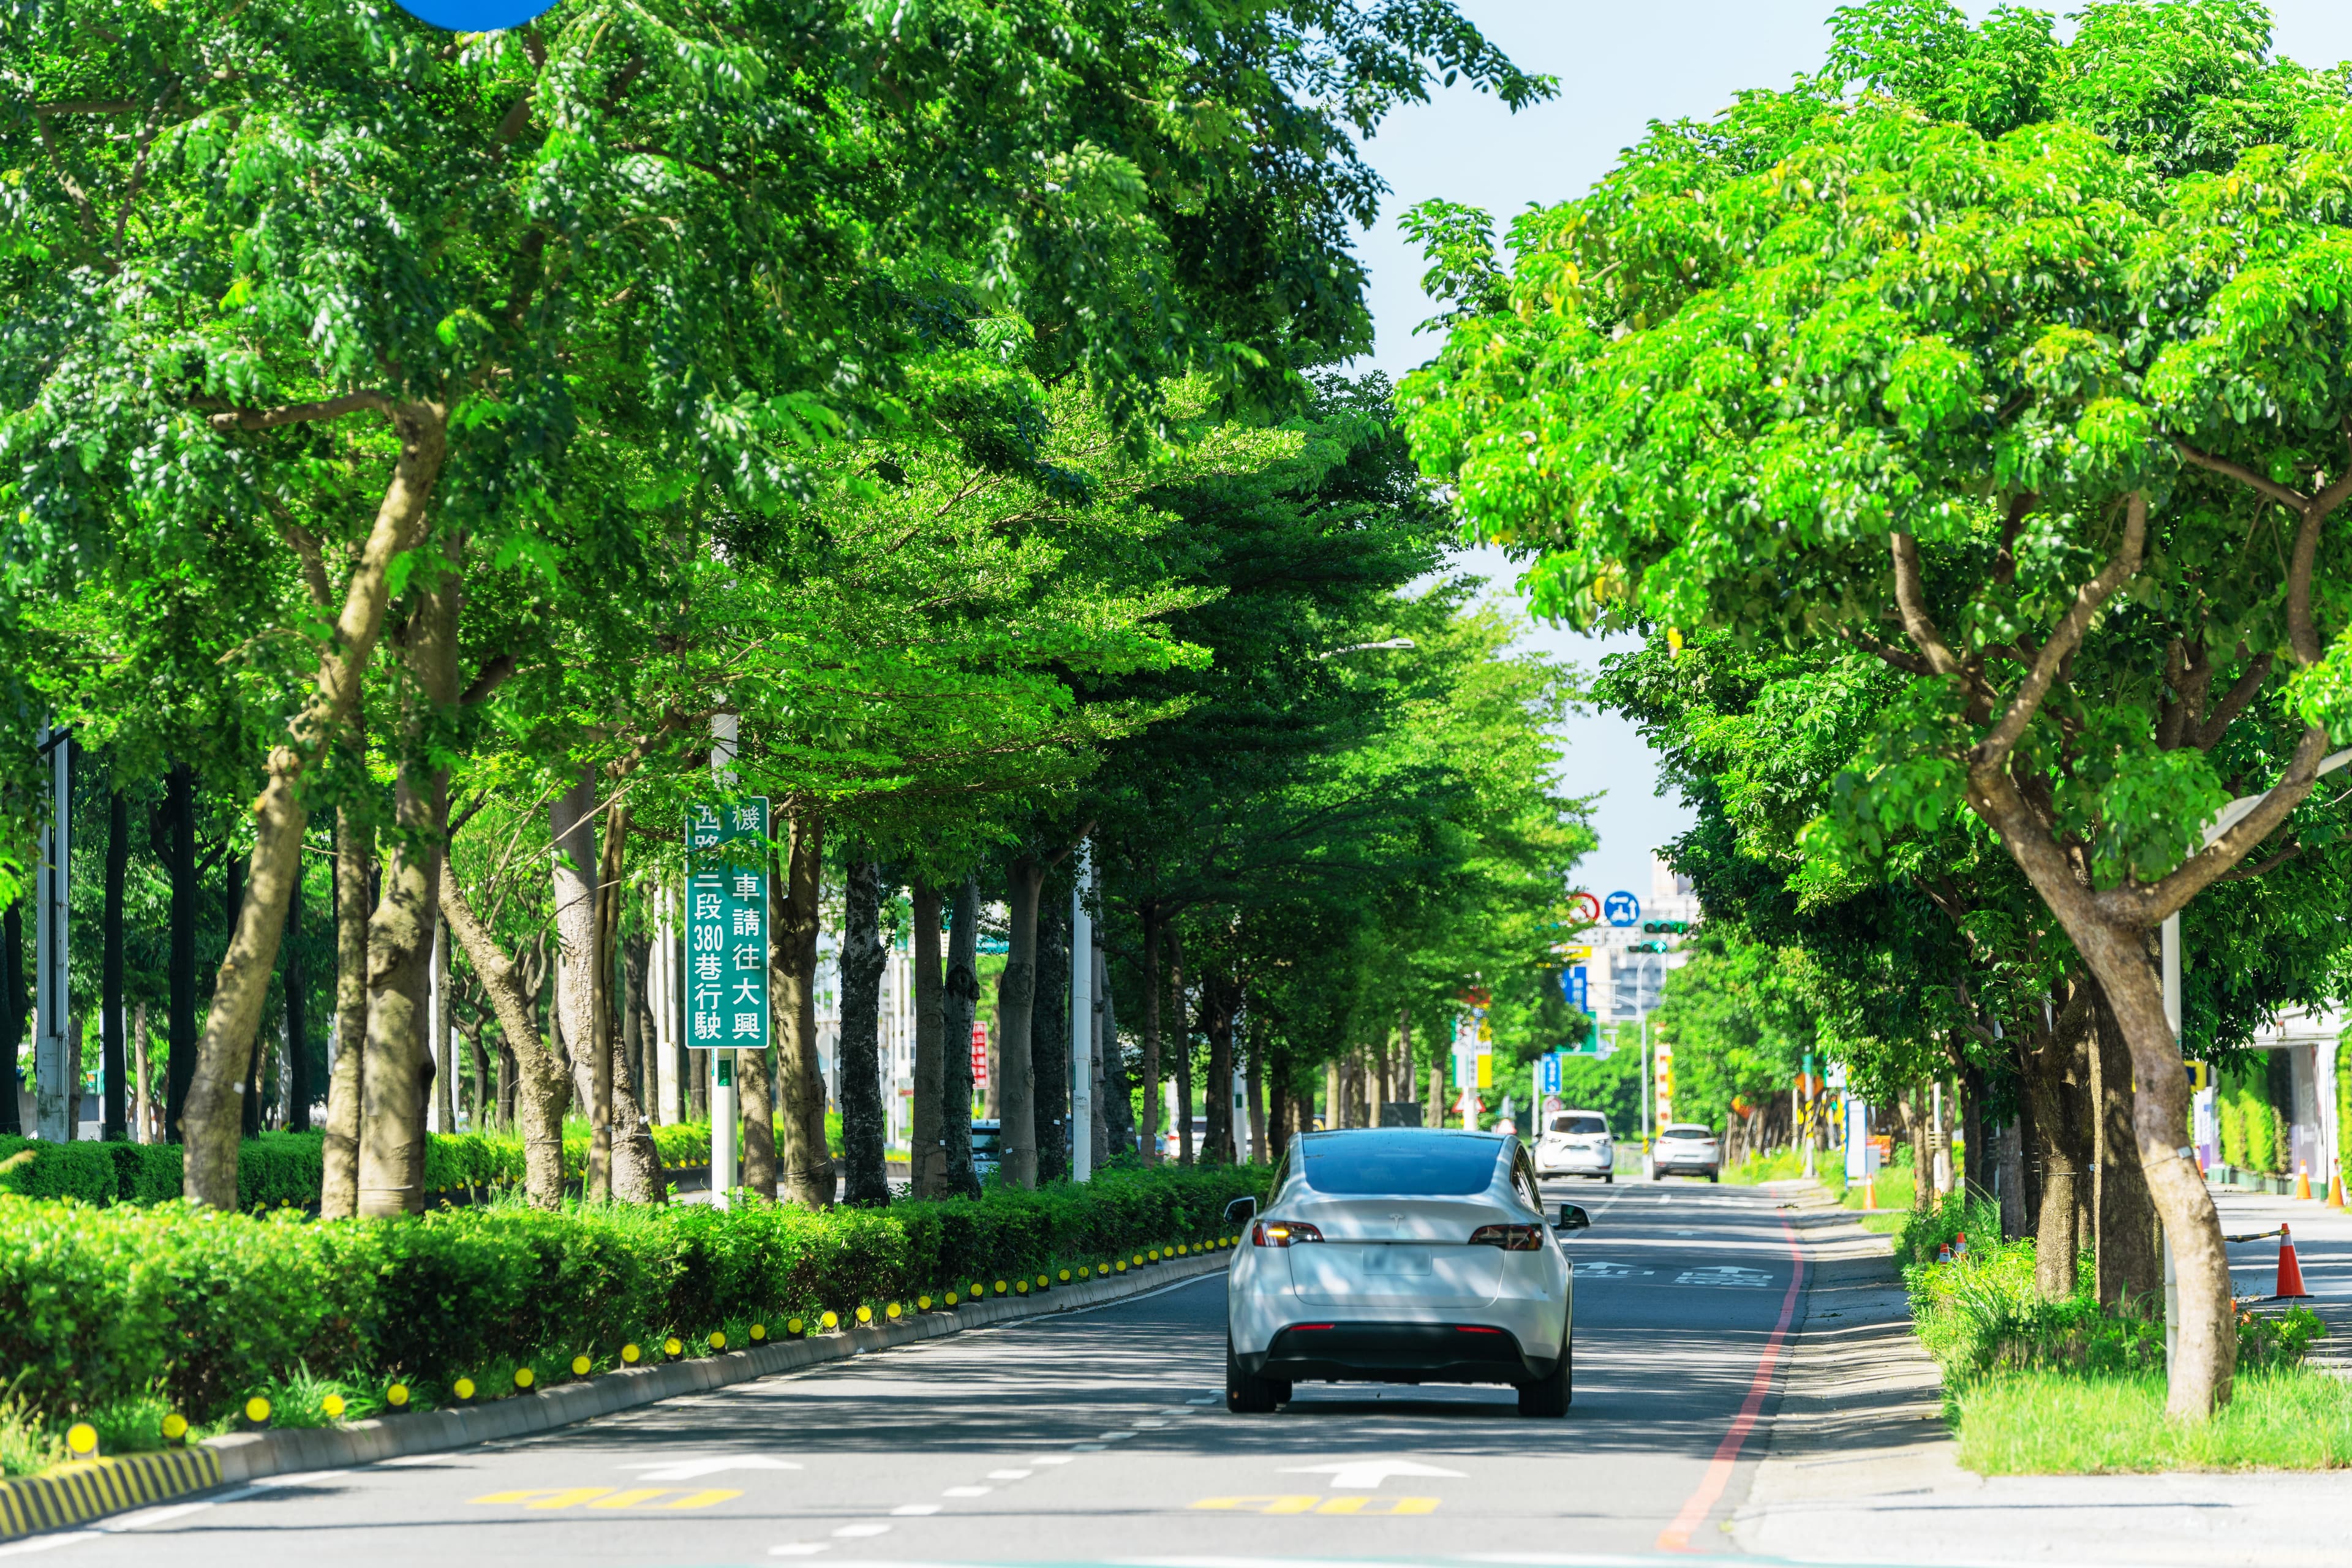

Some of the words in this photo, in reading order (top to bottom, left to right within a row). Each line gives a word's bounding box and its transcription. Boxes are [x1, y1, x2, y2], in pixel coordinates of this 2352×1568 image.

[732, 804, 760, 1039] 機車請往大興
